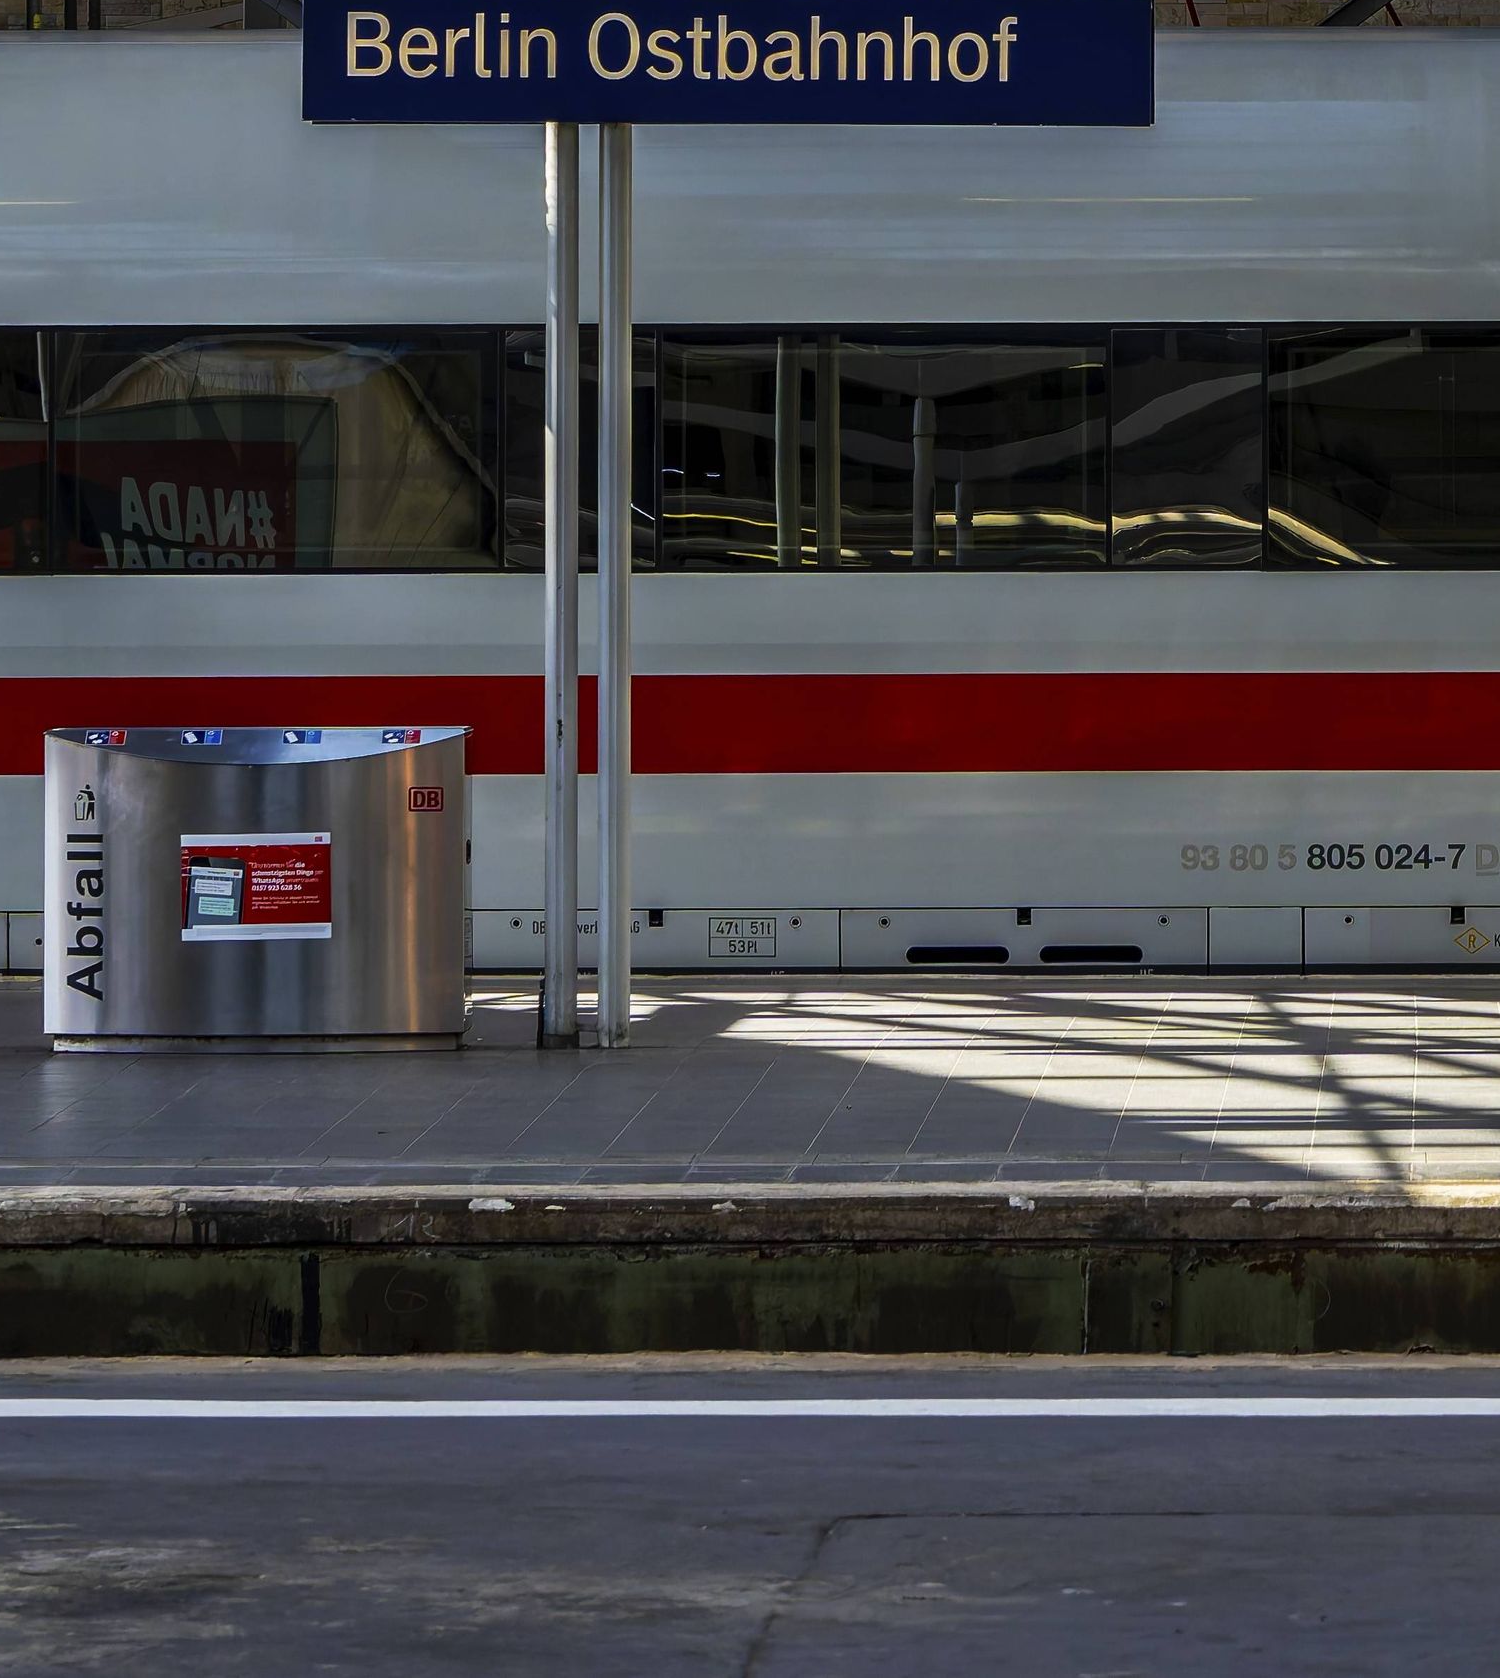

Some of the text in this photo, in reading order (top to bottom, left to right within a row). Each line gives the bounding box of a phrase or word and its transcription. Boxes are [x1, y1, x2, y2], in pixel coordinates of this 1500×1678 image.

[345, 11, 1019, 83] Berlin Ostbahnhof
[411, 789, 441, 809] DB
[1180, 844, 1220, 871] 93
[1229, 844, 1268, 871] 80
[1277, 844, 1297, 871] 5
[1306, 843, 1365, 870] 805
[1375, 843, 1467, 870] 024-7
[66, 833, 104, 1002] Abfall
